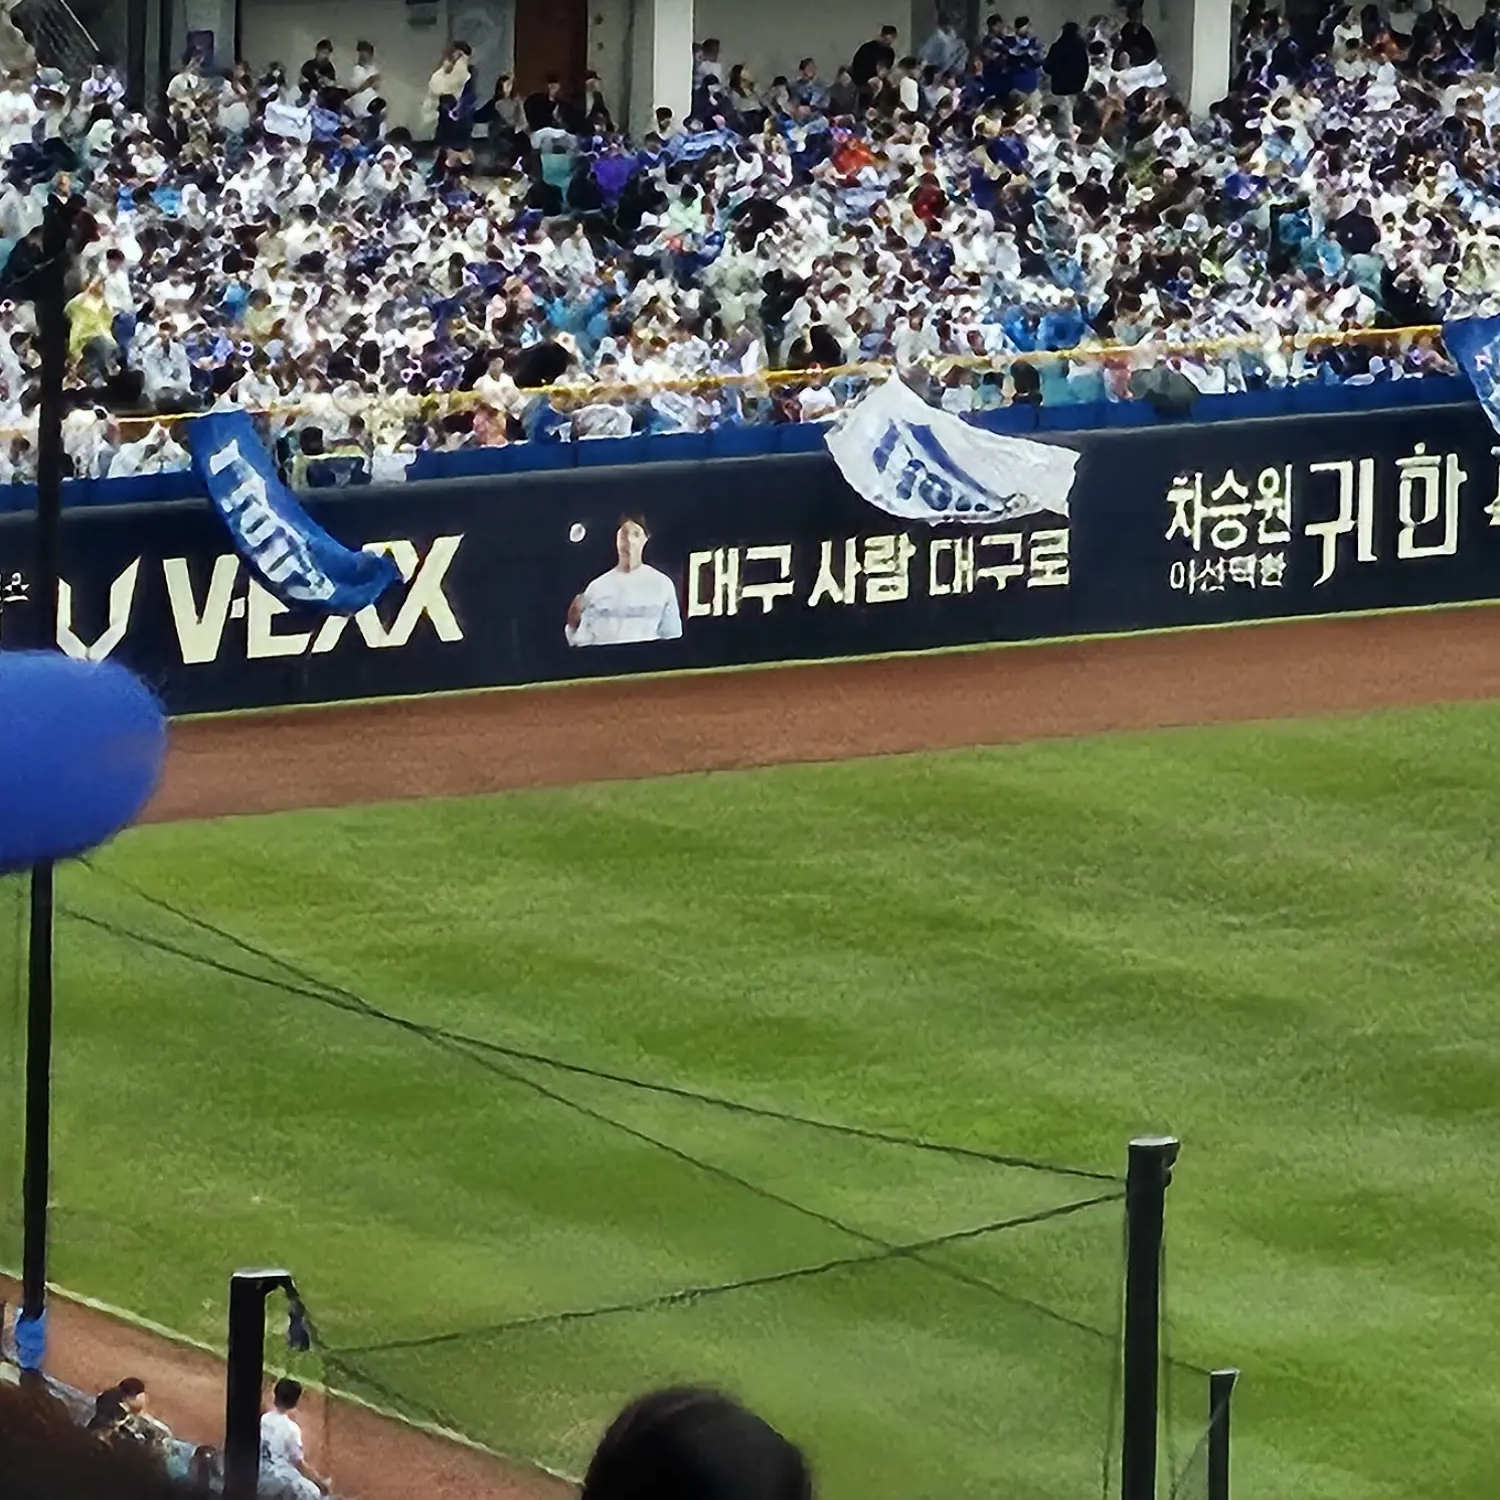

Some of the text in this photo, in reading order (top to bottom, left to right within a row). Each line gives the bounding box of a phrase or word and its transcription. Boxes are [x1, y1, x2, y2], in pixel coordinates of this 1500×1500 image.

[1164, 462, 1294, 552] 차승원
[687, 527, 1071, 618] 대구 사람 대구로
